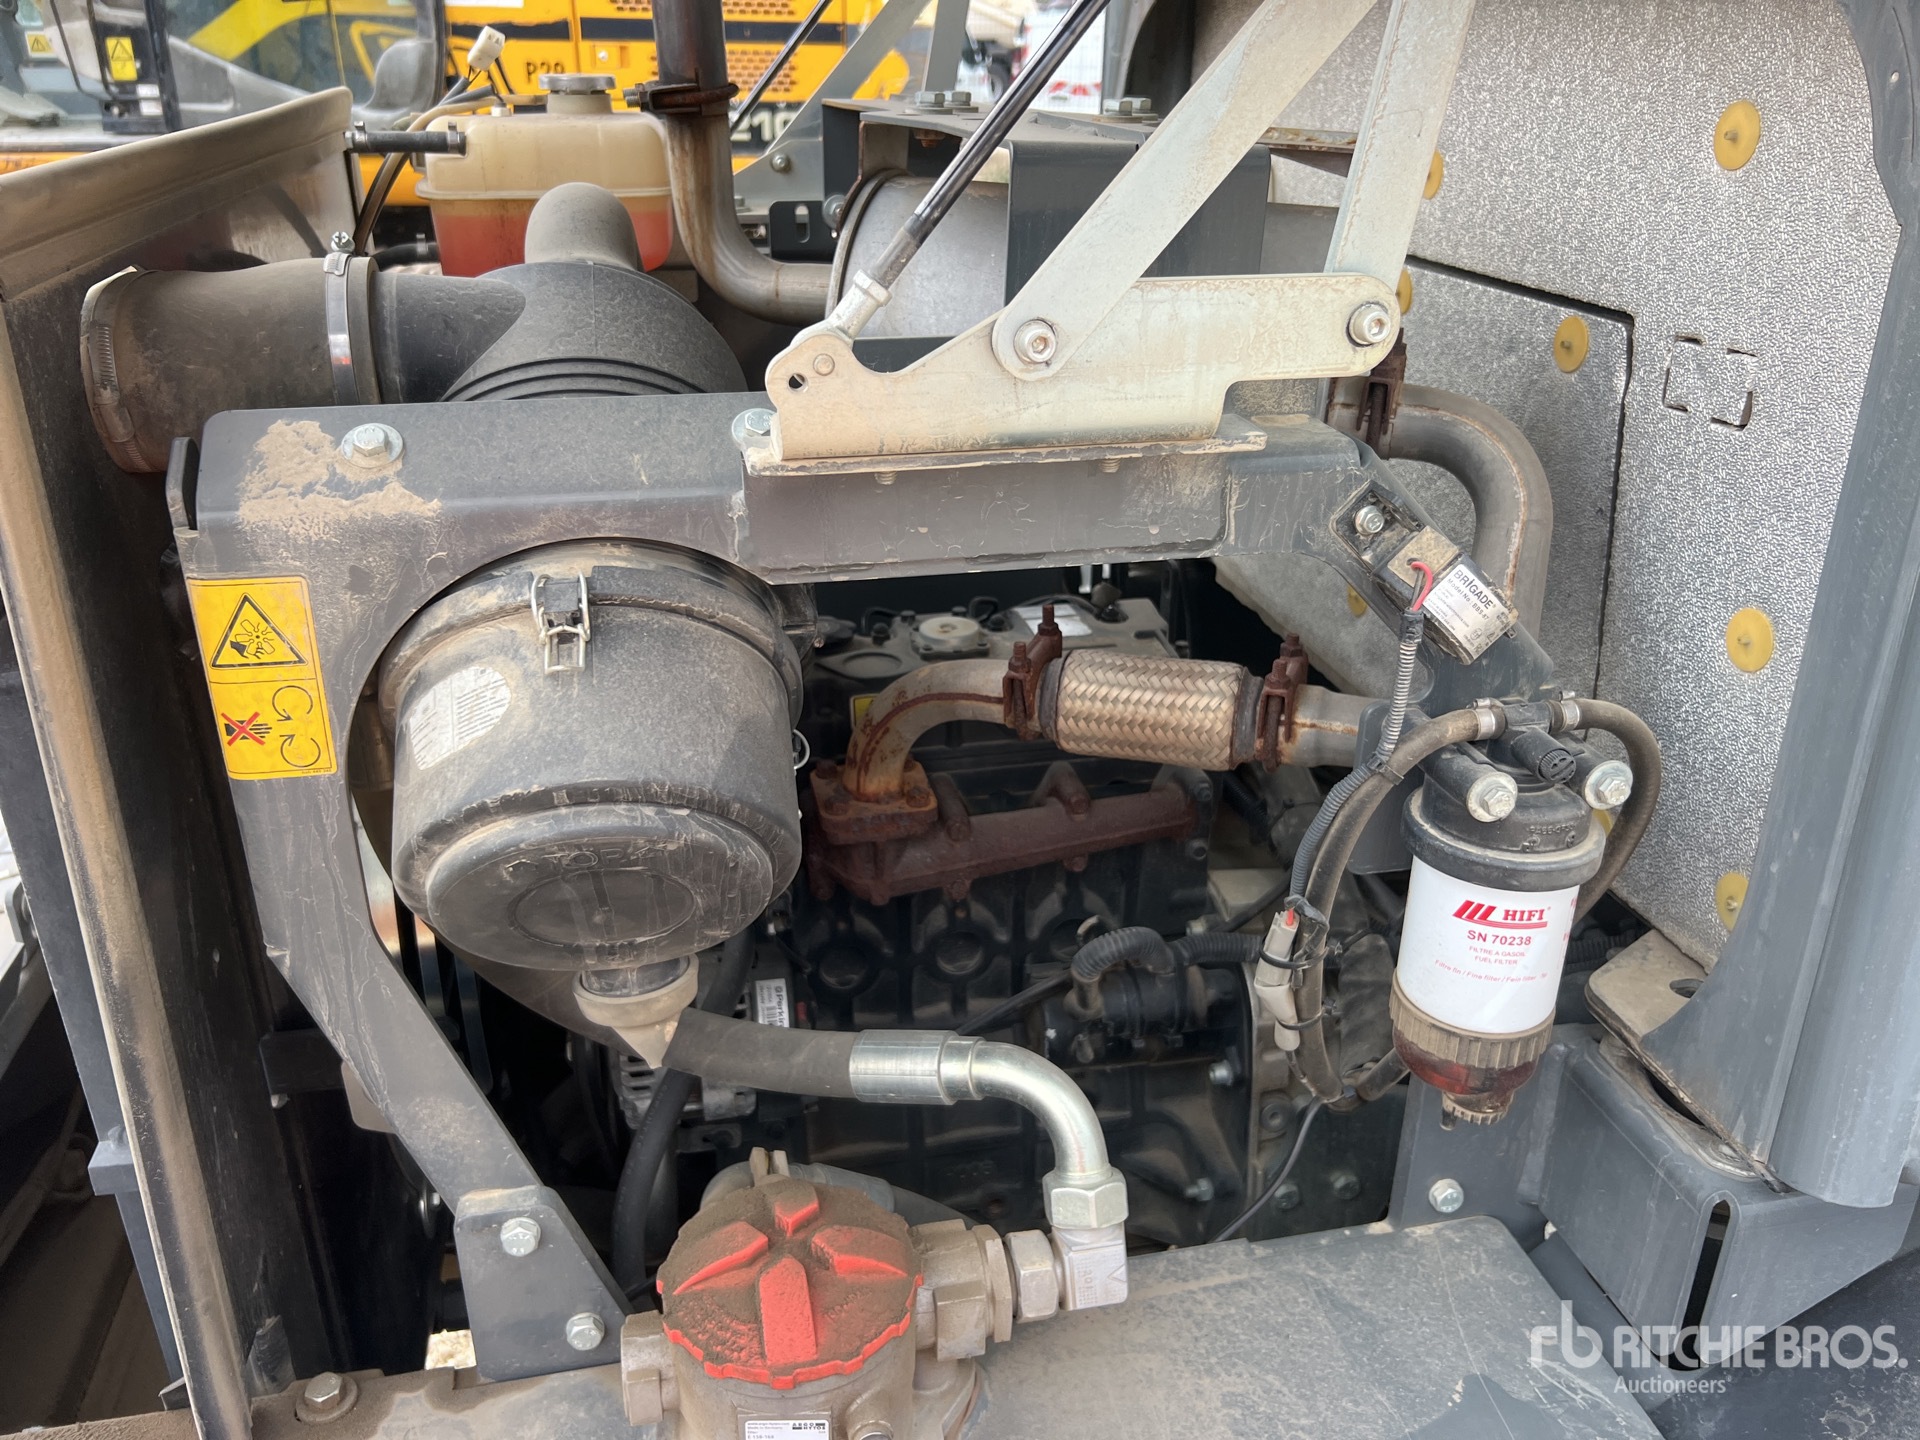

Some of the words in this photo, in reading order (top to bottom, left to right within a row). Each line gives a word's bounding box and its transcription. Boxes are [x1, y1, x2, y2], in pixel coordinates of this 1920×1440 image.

[1446, 577, 1464, 595] Model
[1453, 569, 1494, 610] BRIGADE
[1502, 909, 1545, 921] HIFI
[1467, 930, 1487, 942] SN
[1492, 935, 1532, 946] 70238
[1469, 946, 1493, 955] FILTRE
[1434, 959, 1452, 971] Filtre
[1474, 956, 1492, 964] FUEL
